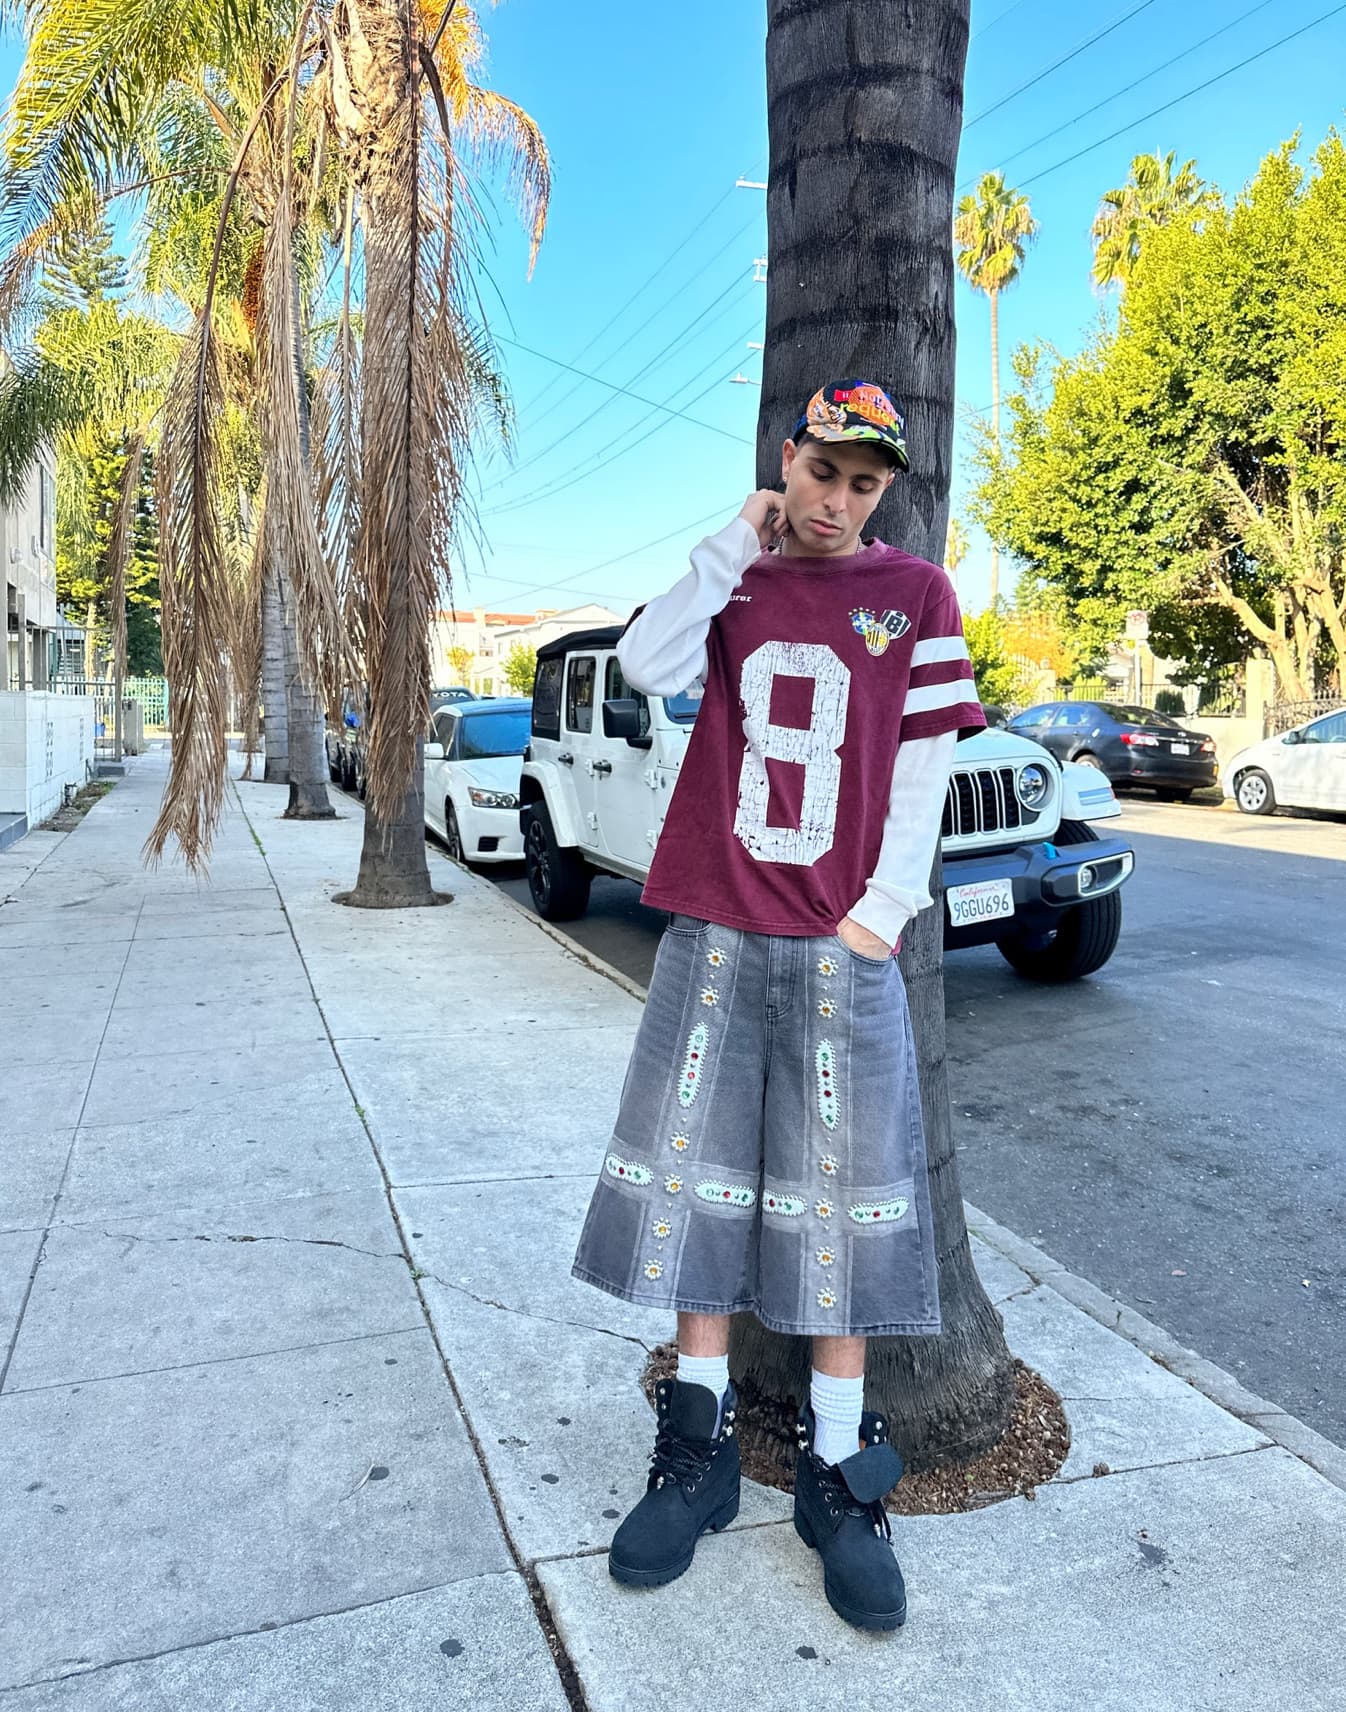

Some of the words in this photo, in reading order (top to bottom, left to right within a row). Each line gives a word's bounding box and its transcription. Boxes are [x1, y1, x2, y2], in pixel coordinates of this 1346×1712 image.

[432, 691, 469, 699] YOTA
[732, 641, 852, 867] 8
[953, 892, 1009, 921] 9GGU696
